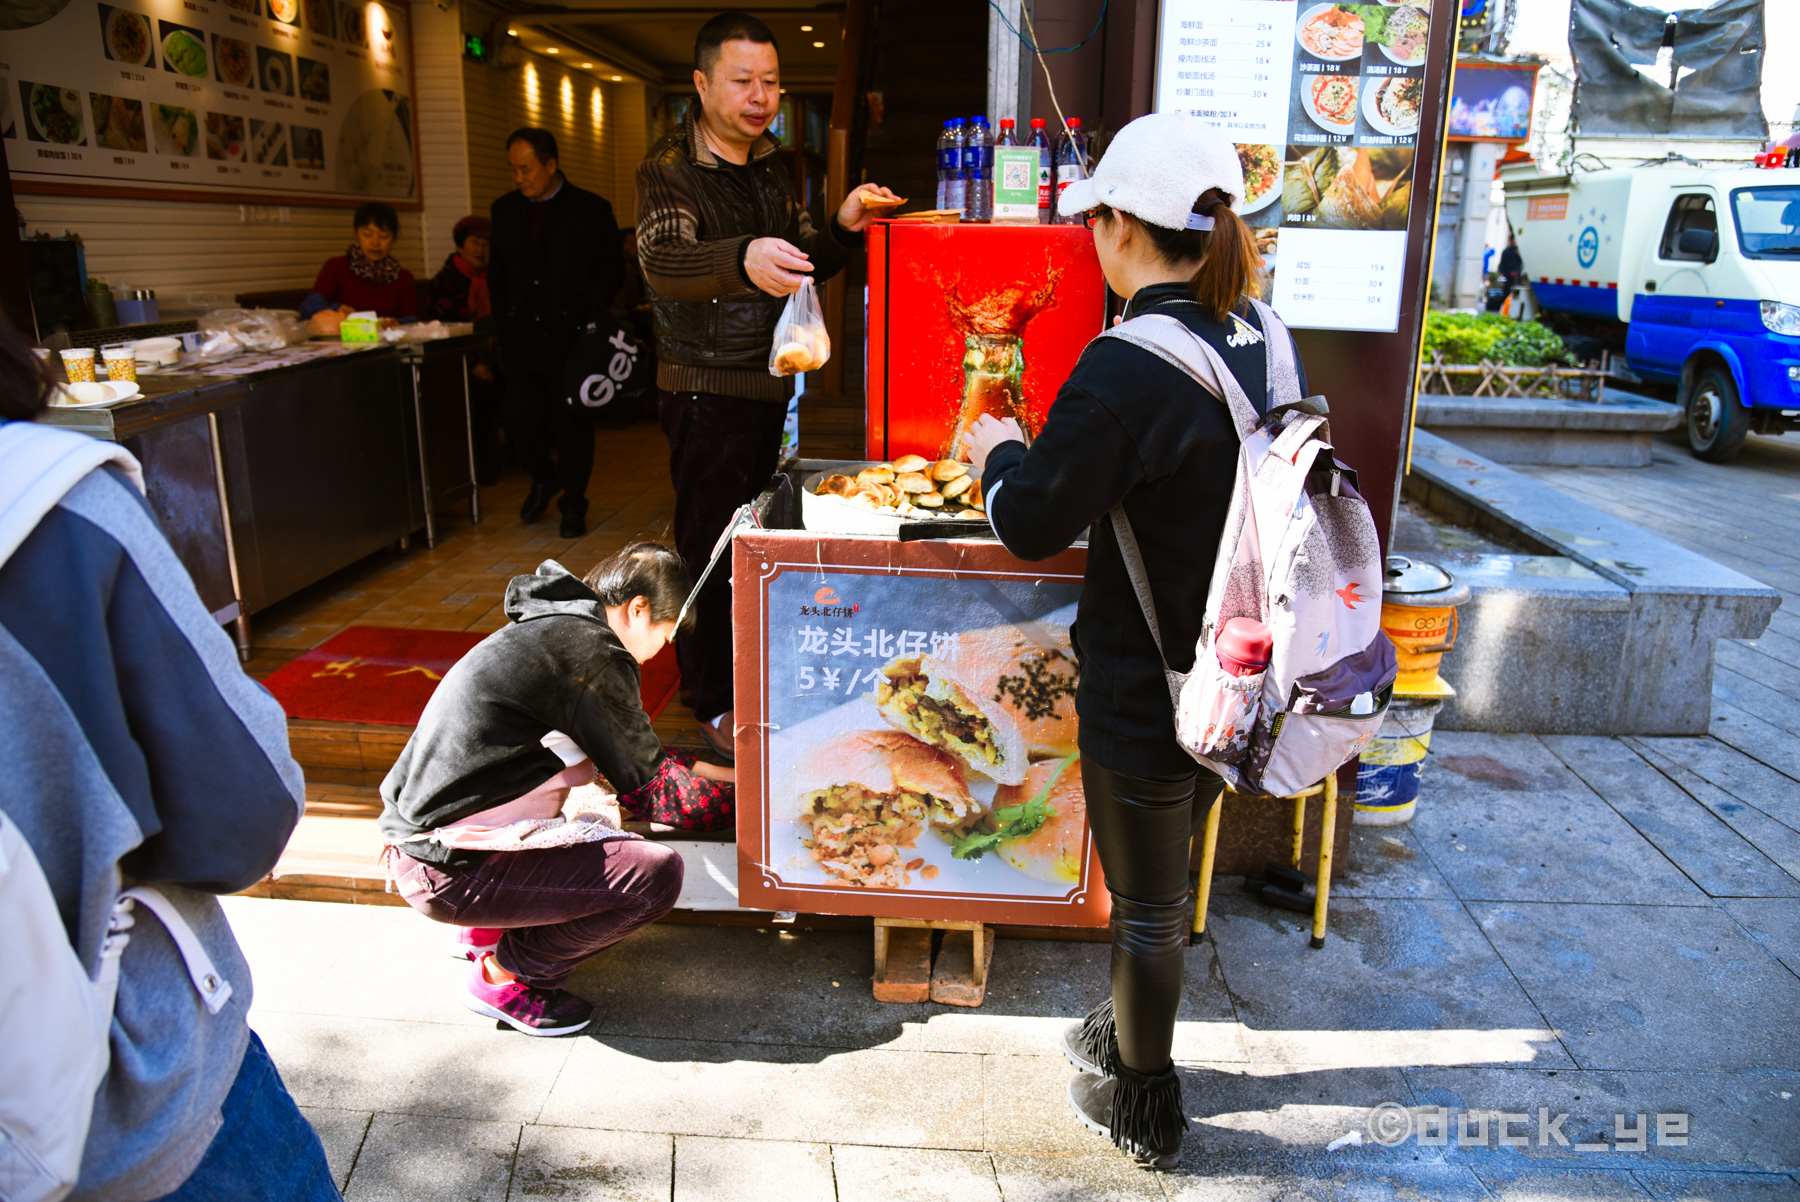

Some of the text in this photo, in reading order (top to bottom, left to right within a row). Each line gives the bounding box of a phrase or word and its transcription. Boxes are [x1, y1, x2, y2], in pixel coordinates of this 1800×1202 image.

[1180, 20, 1204, 30] 海鲜面
[1179, 37, 1218, 47] 海鲜沙茶面
[1300, 63, 1321, 72] 沙茶面
[1176, 87, 1215, 97] 炒厦门面线
[799, 605, 855, 618] 龙头北仔饼
[798, 625, 960, 661] 龙头北仔饼
